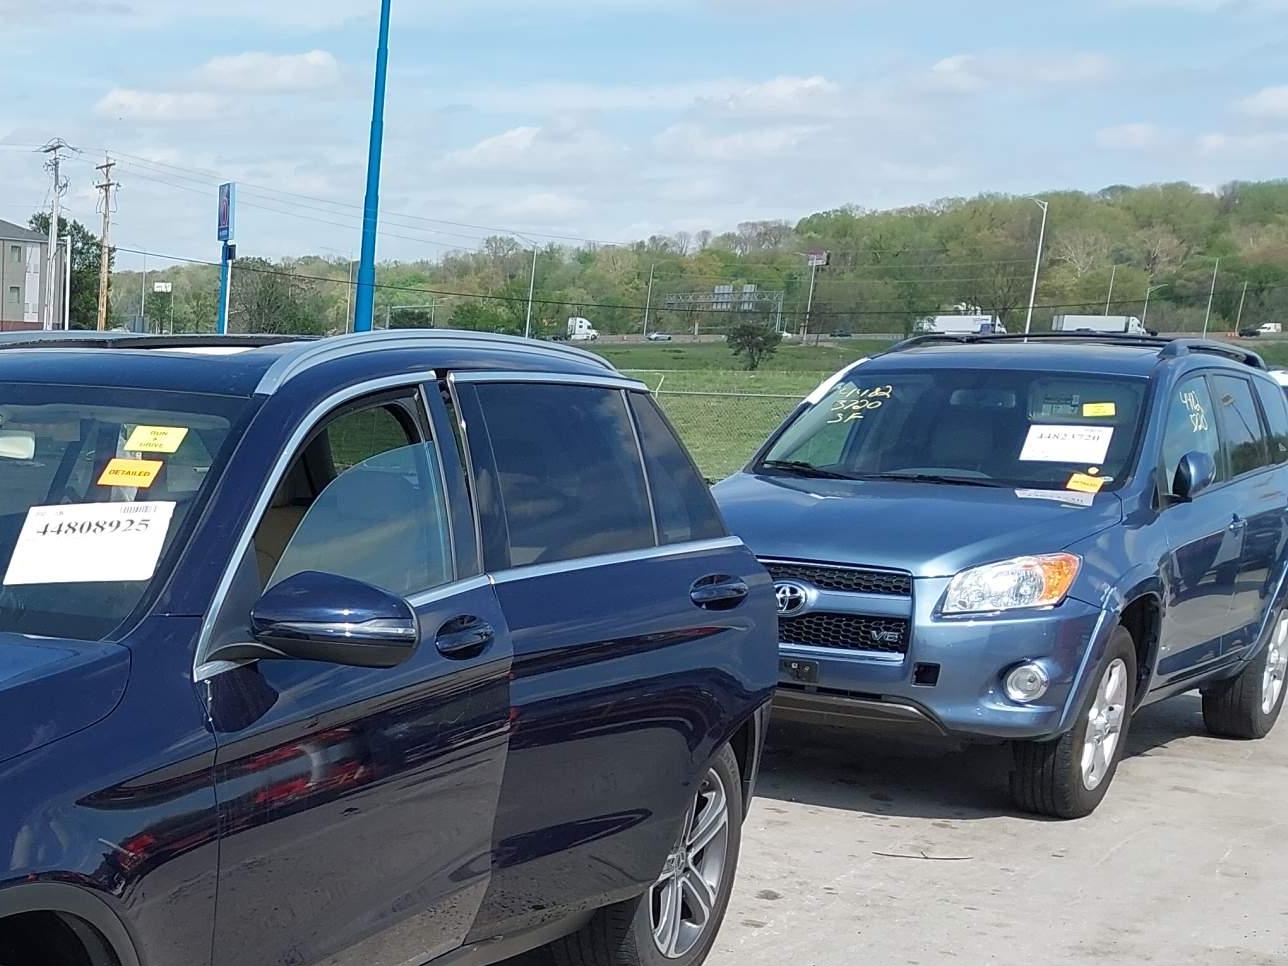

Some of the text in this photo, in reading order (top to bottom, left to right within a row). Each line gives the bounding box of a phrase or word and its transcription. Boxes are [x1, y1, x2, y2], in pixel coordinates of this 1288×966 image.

[108, 469, 151, 477] DETAILED
[36, 519, 150, 536] 44808925
[871, 630, 900, 642] V6
